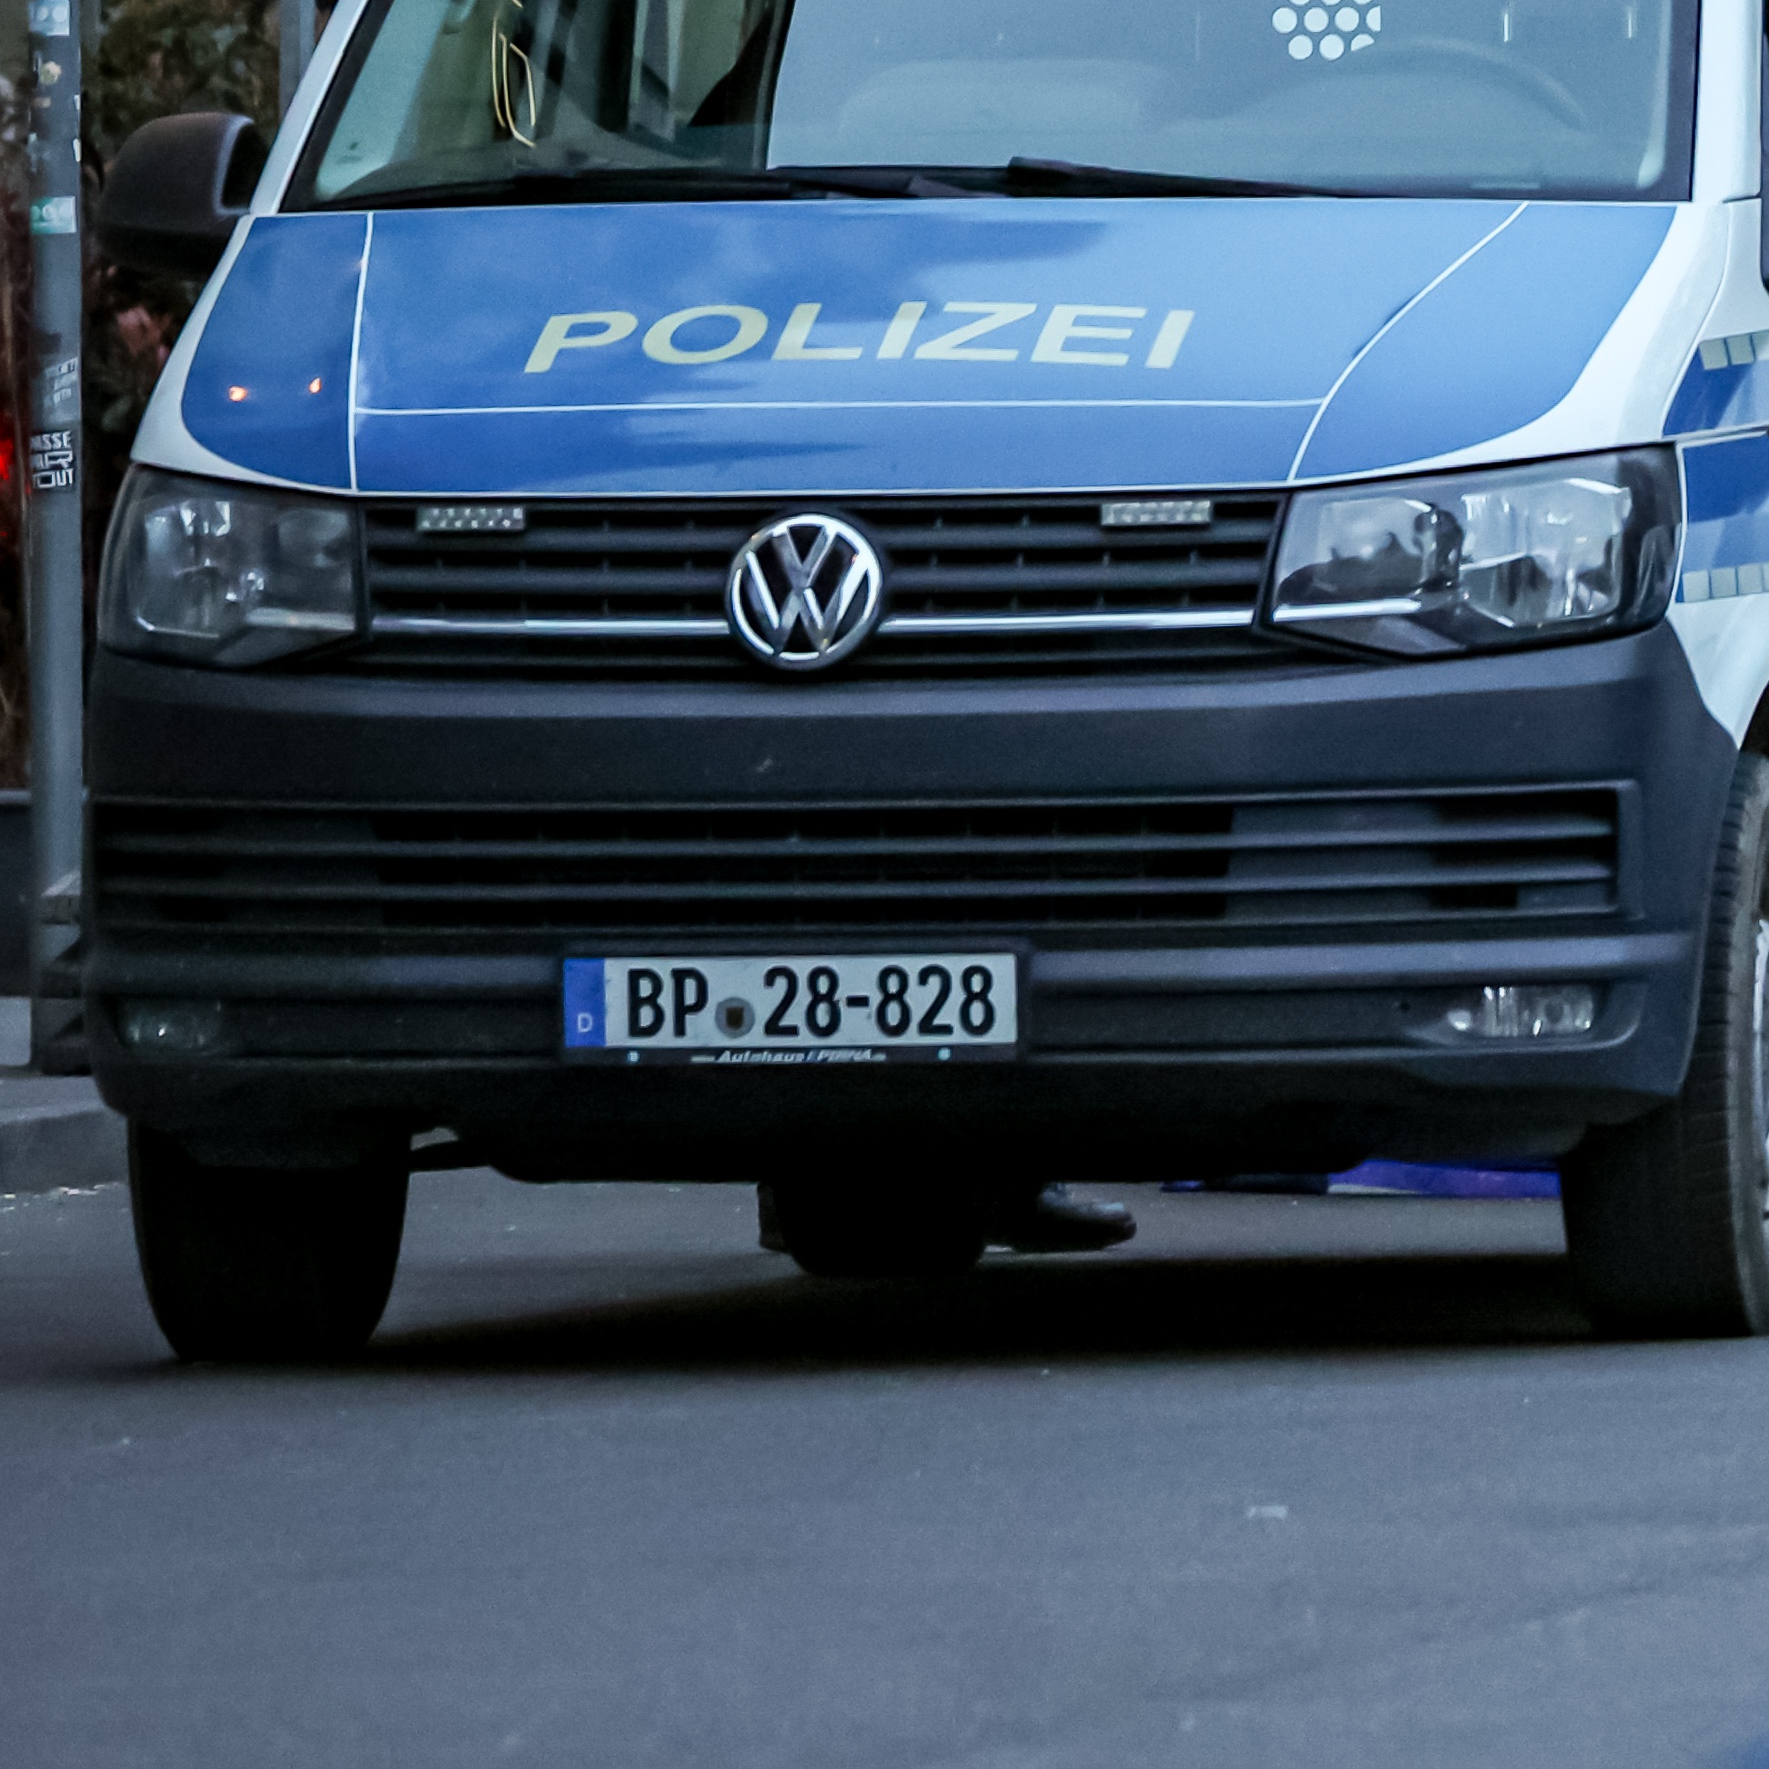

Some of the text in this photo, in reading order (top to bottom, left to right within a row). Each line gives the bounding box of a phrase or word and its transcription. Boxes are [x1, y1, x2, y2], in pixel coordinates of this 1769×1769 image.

[523, 300, 1197, 374] POLIZEI
[577, 1011, 593, 1033] D
[626, 965, 996, 1038] BP 28-828
